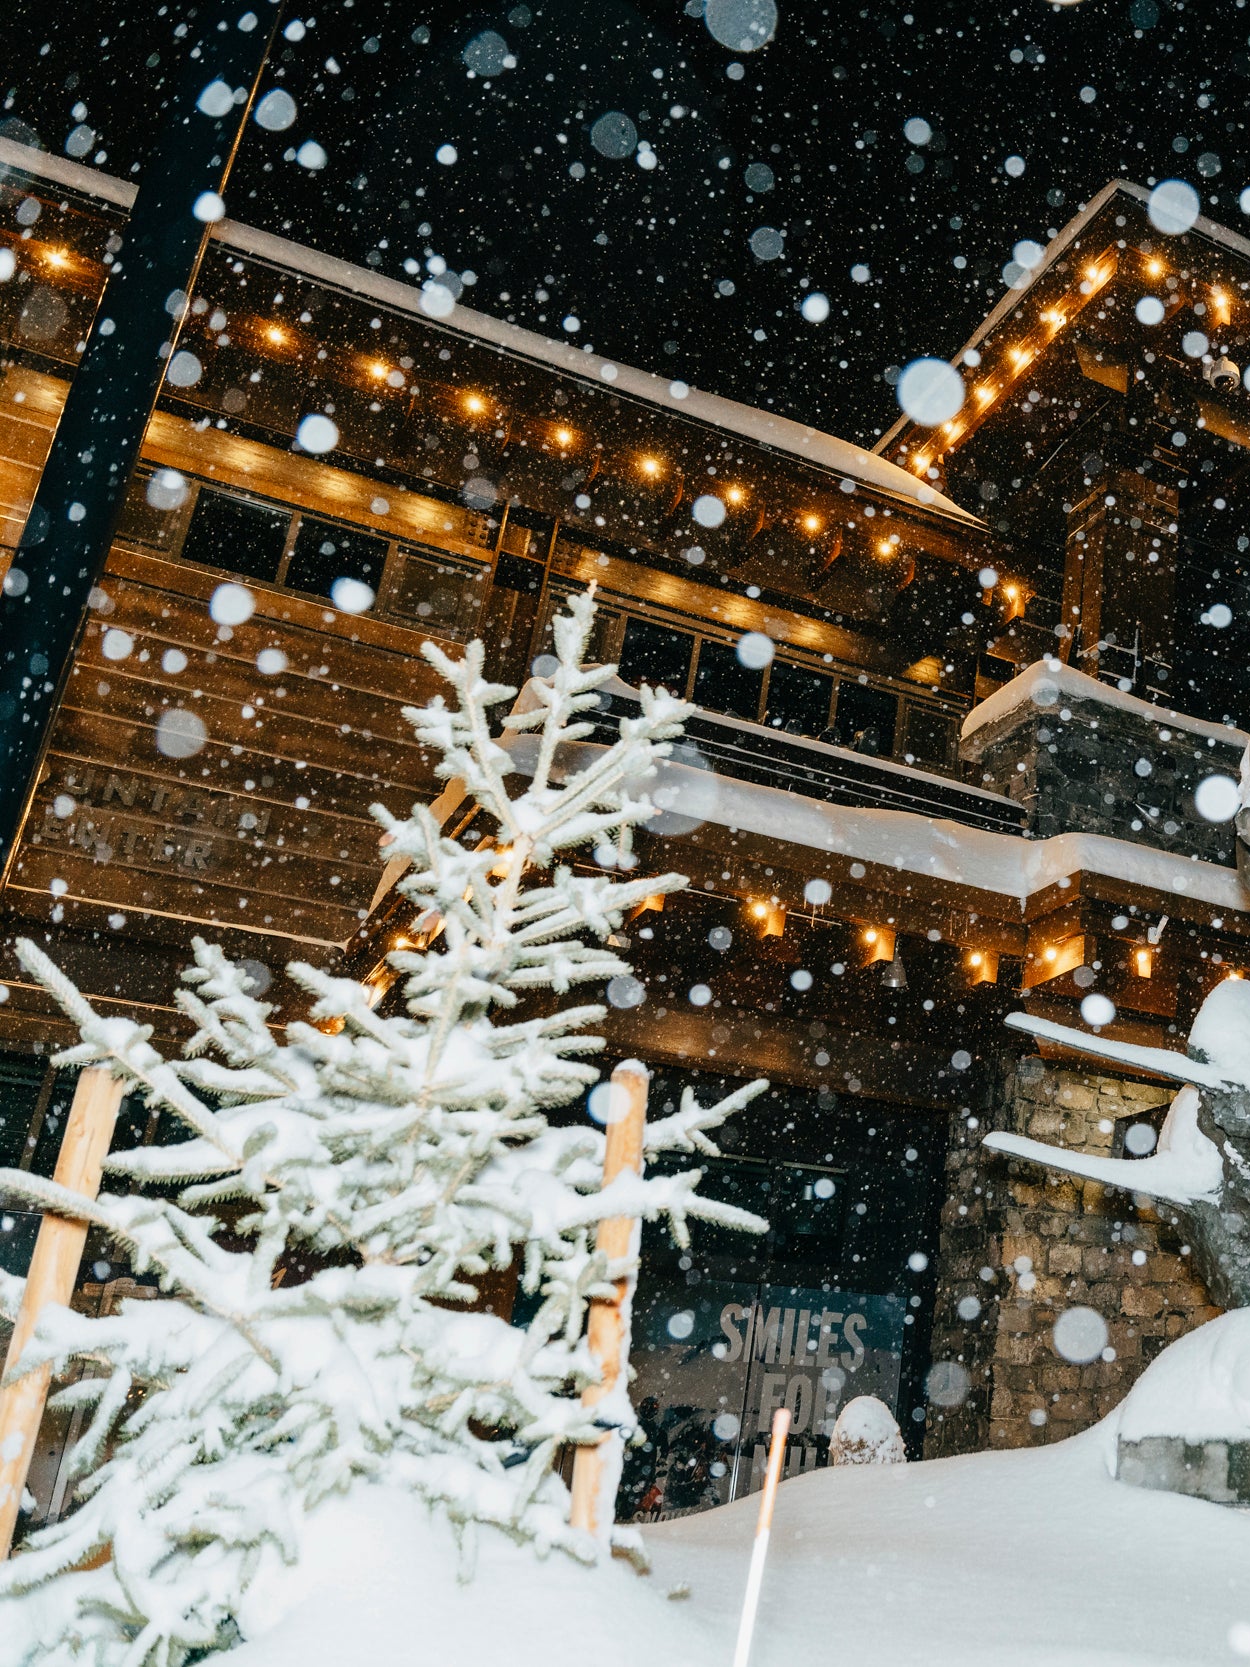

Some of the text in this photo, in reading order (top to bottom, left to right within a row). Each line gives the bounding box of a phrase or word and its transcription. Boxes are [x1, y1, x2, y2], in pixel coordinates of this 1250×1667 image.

[38, 760, 272, 835] UNTAIN
[719, 1303, 867, 1370] SMILES
[757, 1372, 843, 1436] FOR
